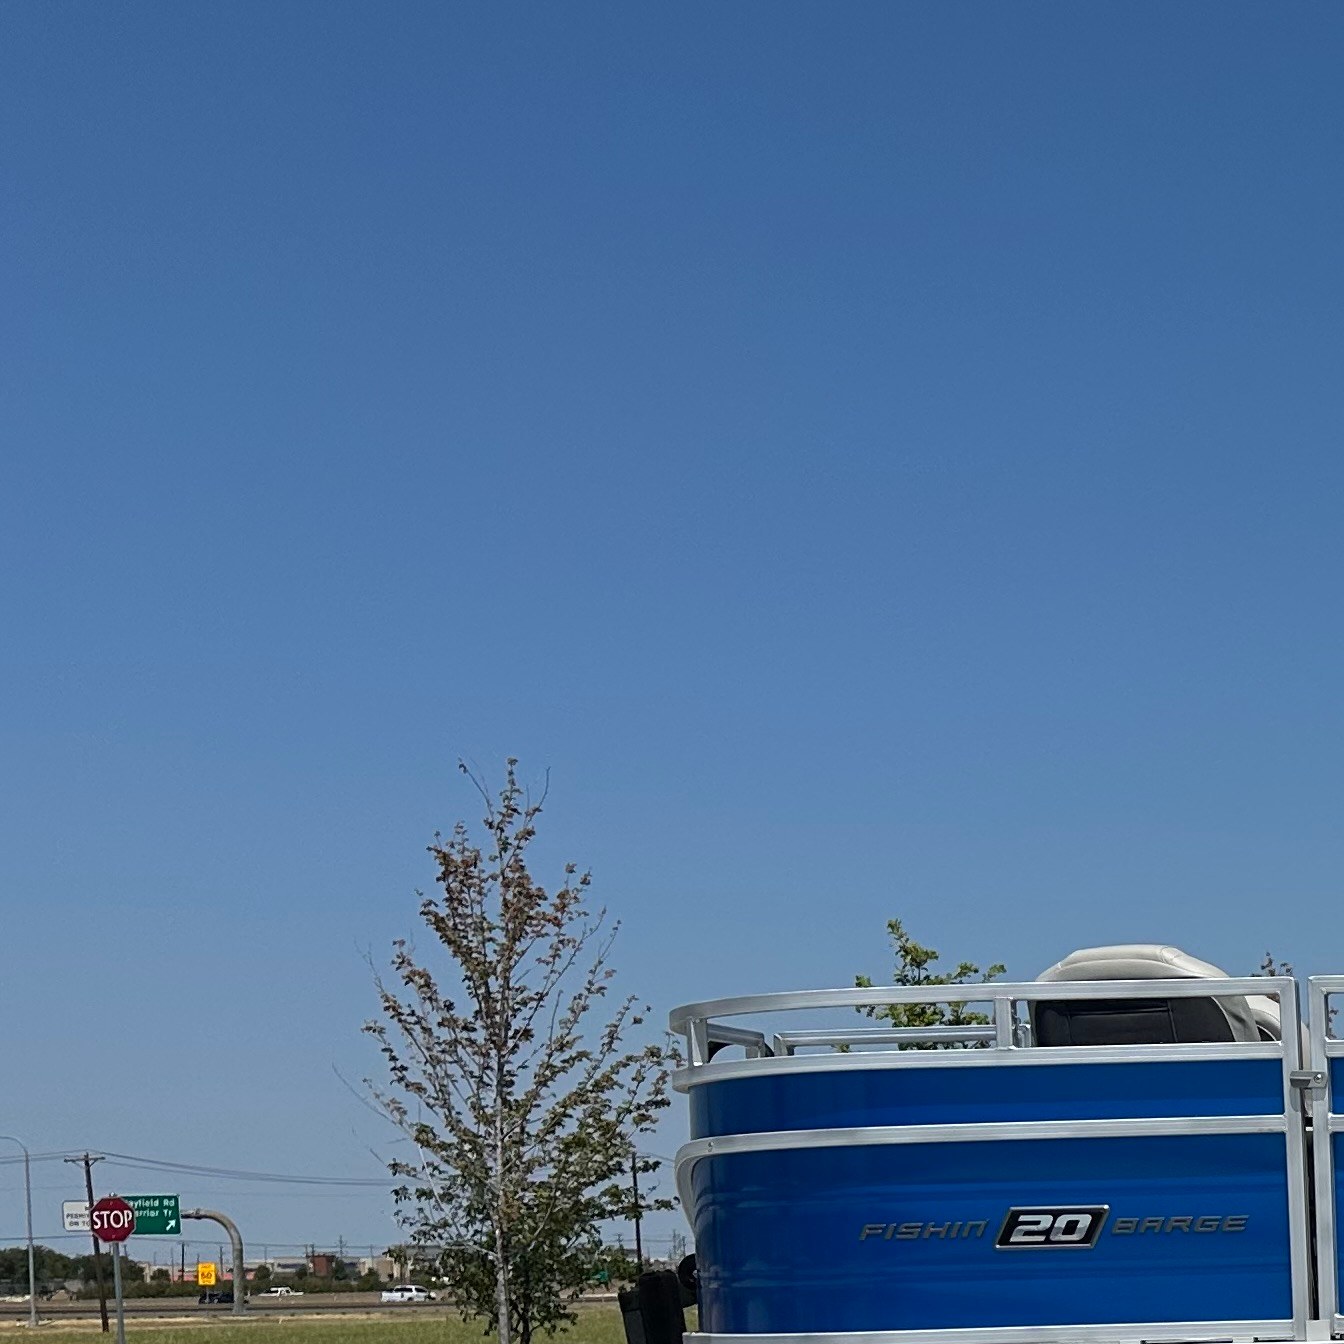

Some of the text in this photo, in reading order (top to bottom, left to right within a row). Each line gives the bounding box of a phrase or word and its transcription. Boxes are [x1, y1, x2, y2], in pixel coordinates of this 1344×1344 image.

[93, 1210, 132, 1229] STOP
[1009, 1213, 1093, 1243] 20
[1111, 1214, 1251, 1235] BARGE
